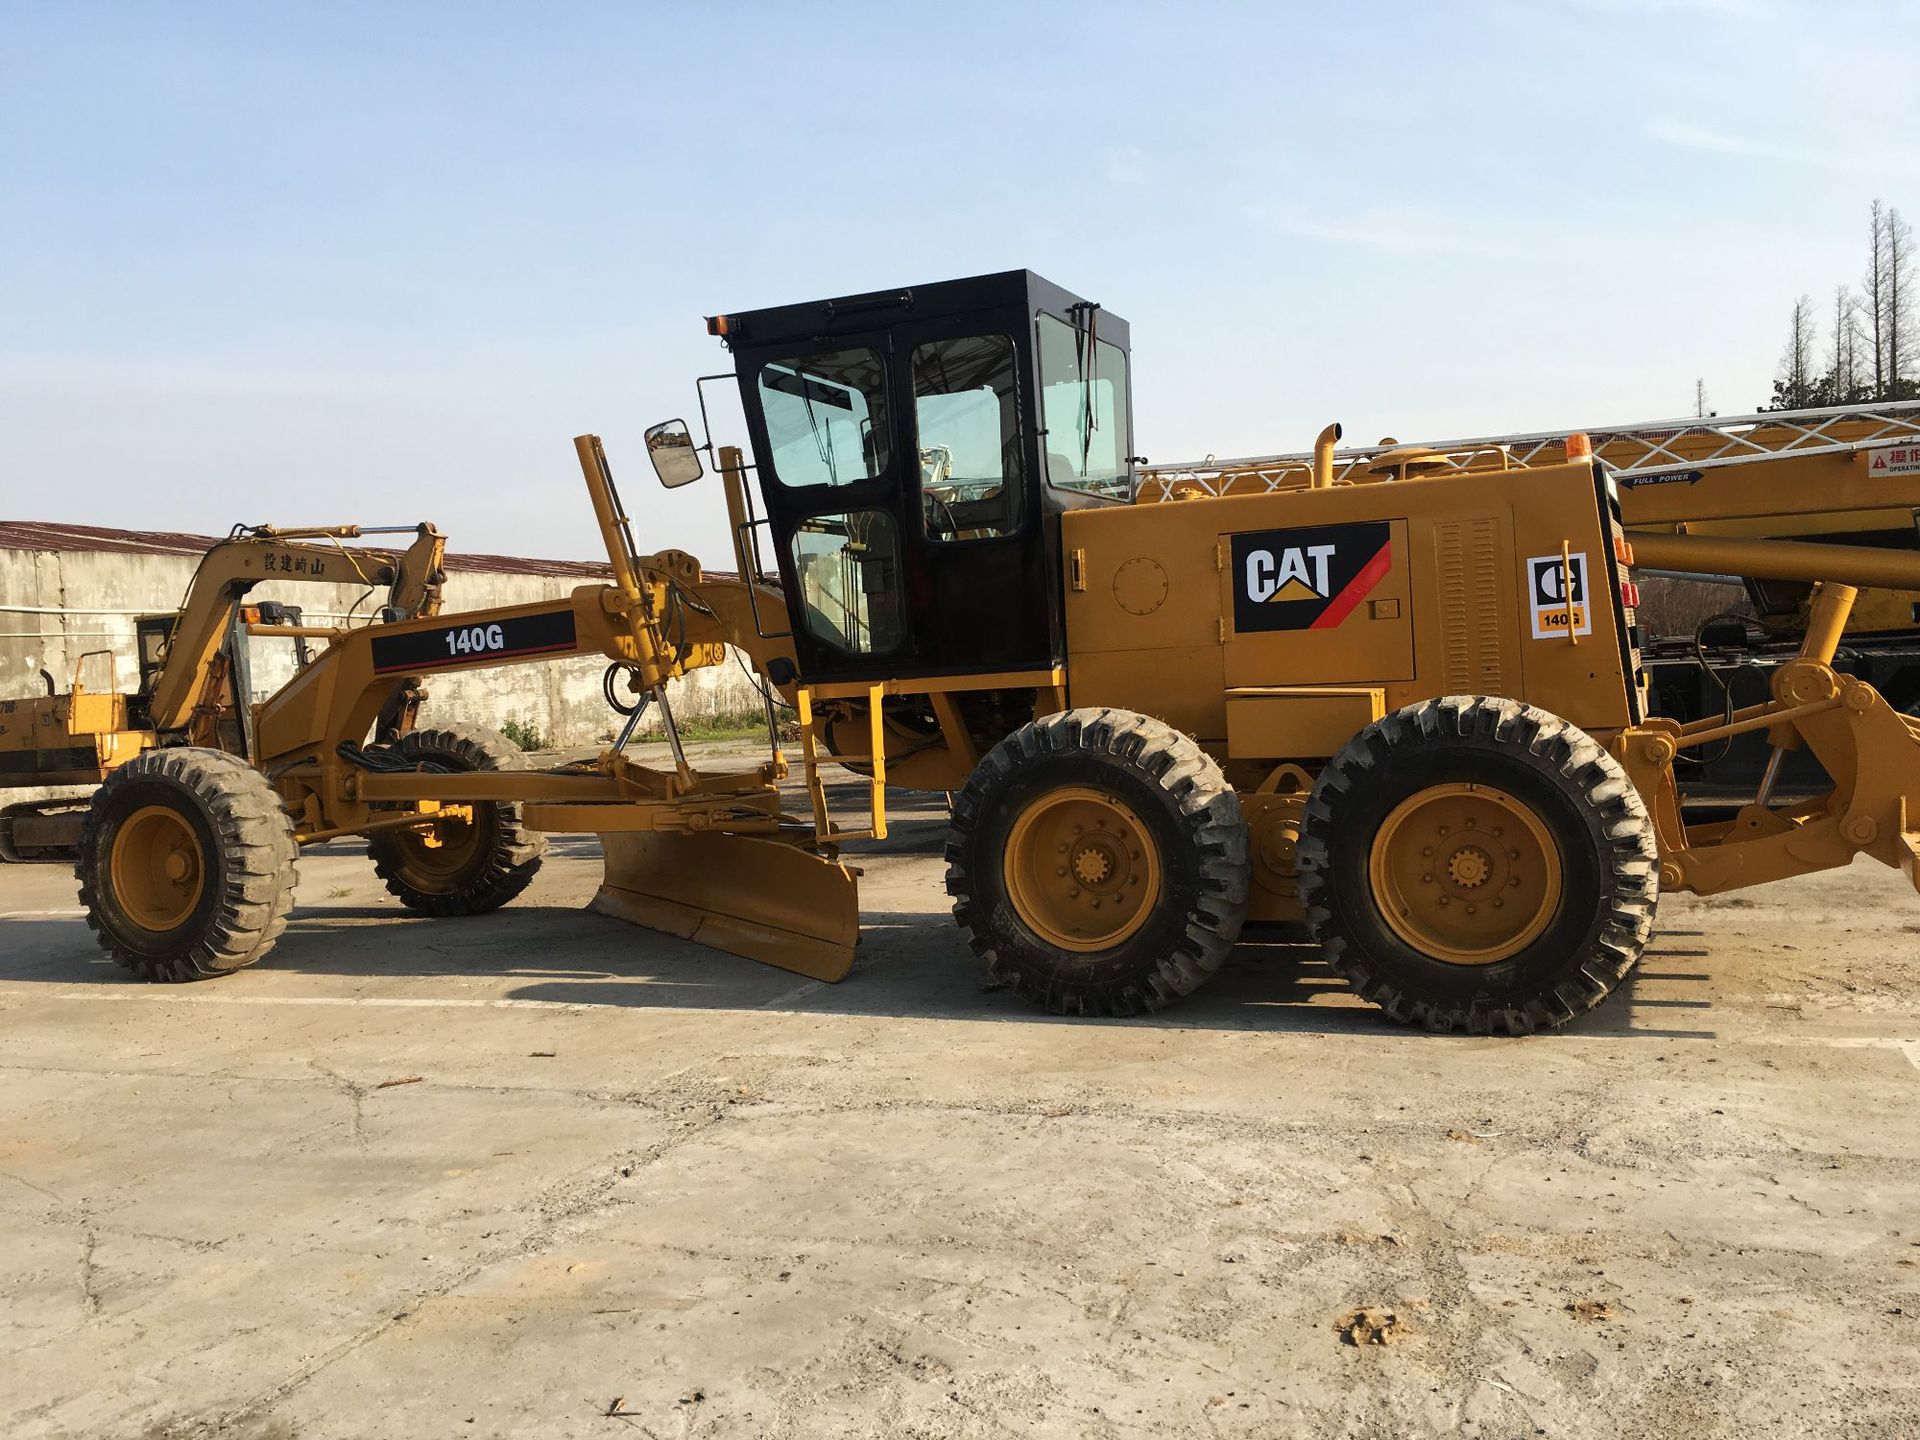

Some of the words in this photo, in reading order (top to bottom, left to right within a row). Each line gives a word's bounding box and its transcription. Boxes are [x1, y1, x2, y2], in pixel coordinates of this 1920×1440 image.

[1633, 477, 1654, 485] FULL
[1658, 473, 1689, 482] POWER
[1246, 544, 1336, 603] CAT
[445, 624, 504, 655] 140G
